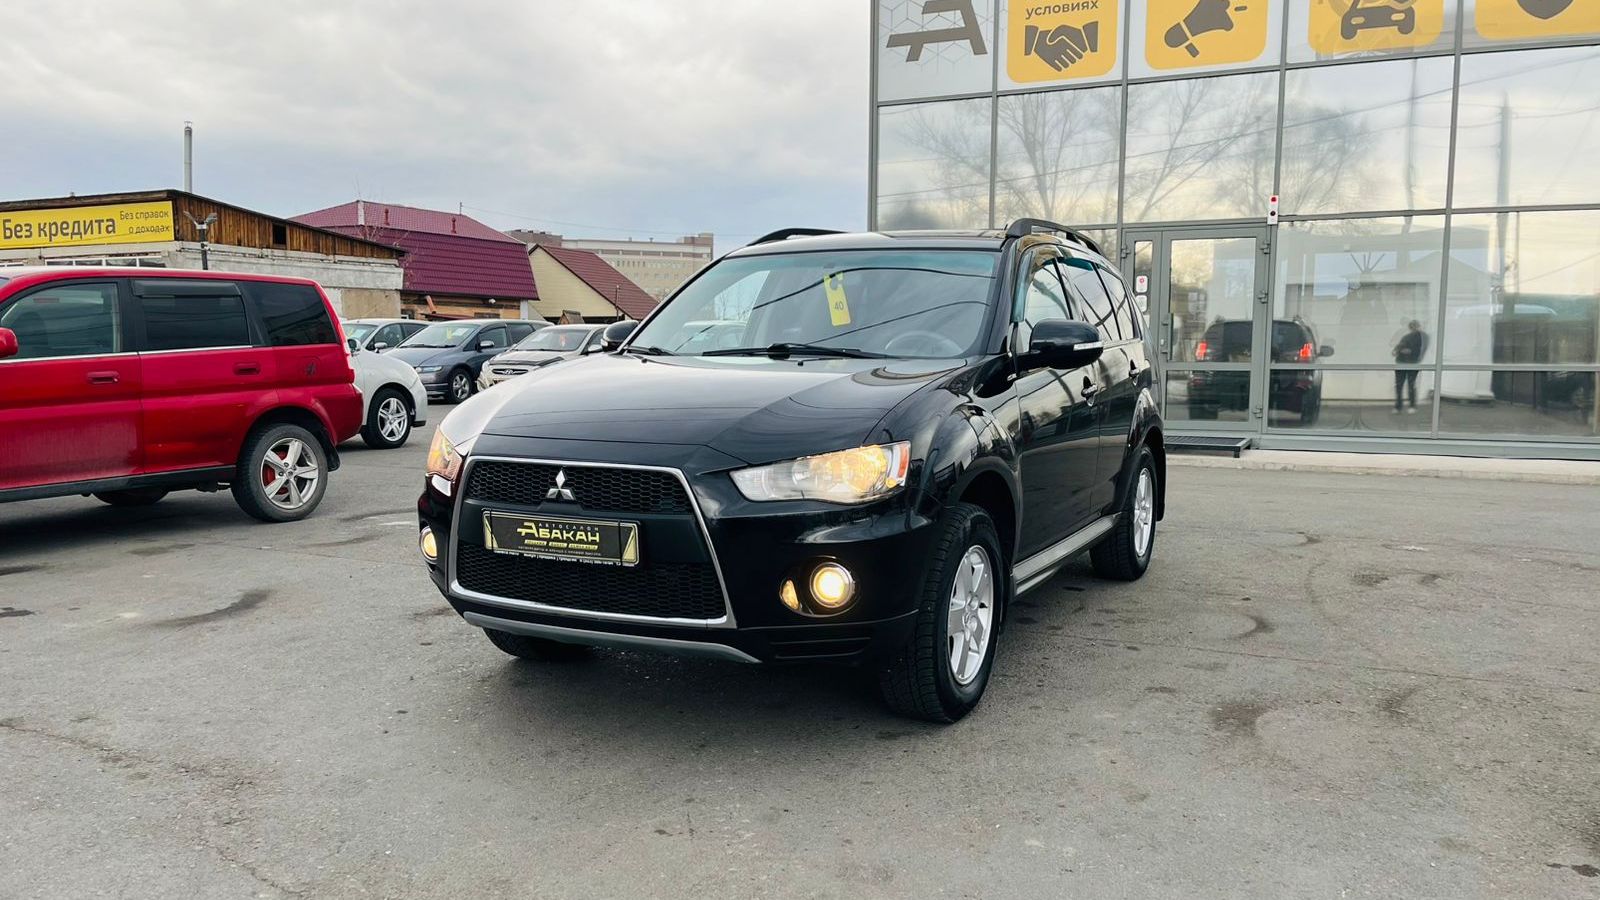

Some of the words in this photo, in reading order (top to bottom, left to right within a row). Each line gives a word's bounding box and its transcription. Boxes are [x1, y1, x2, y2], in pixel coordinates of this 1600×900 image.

[1025, 0, 1098, 20] условиях
[119, 210, 134, 220] Без
[135, 210, 169, 220] справок
[2, 218, 33, 240] Без
[38, 218, 116, 241] кредита
[128, 226, 134, 234] о
[135, 225, 170, 234] доходах
[834, 301, 844, 310] 40
[517, 522, 600, 542] АБАКАН
